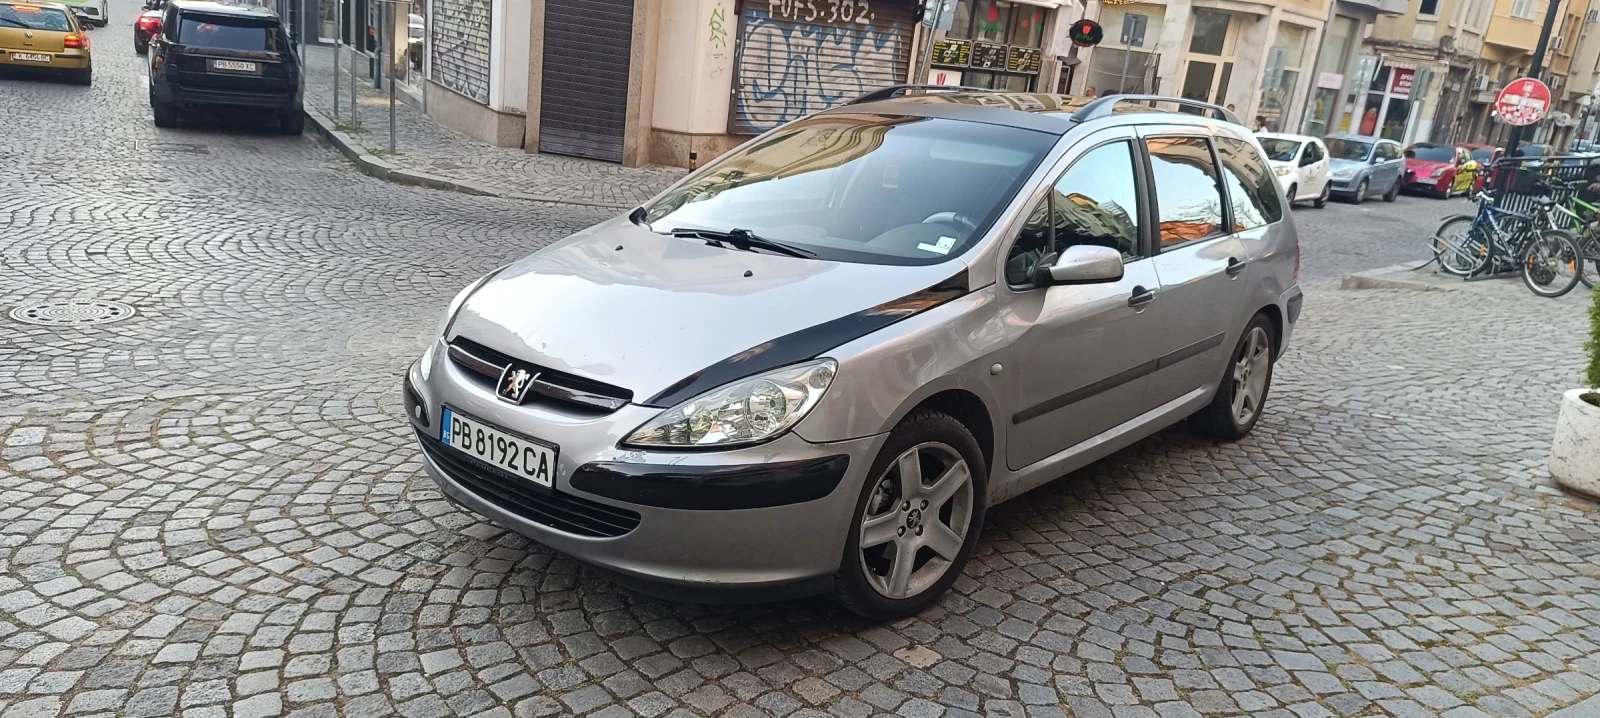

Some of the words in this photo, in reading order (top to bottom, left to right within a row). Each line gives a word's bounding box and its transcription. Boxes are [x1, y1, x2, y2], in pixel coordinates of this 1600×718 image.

[452, 416, 472, 450] PB
[476, 428, 519, 471] 8192
[523, 446, 549, 482] CA
